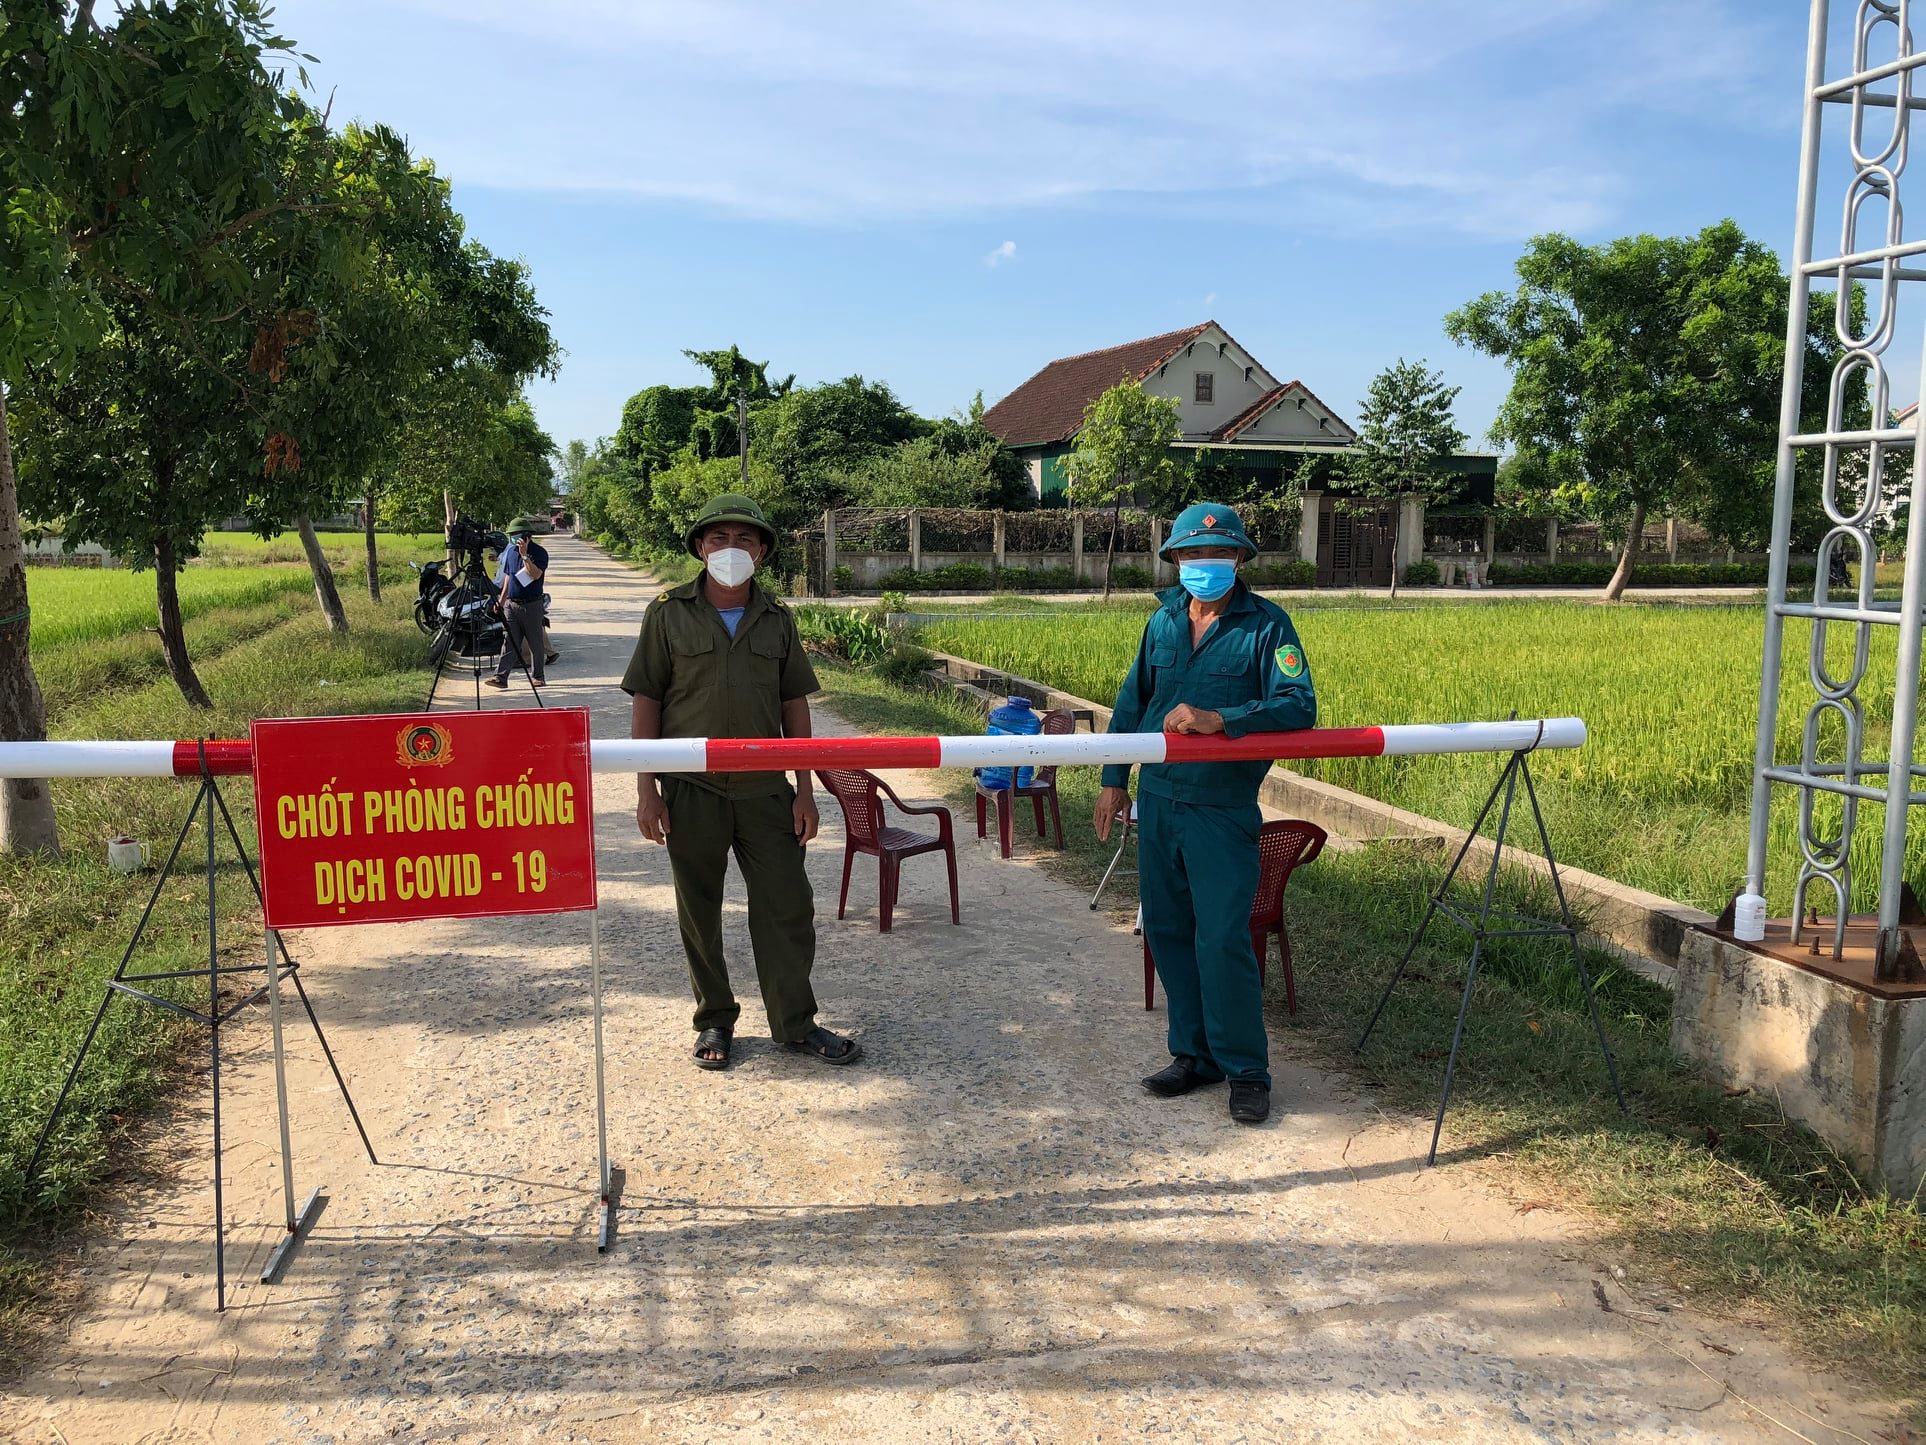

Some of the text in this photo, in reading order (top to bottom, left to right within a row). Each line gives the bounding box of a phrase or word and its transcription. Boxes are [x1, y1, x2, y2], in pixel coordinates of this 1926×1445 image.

[277, 768, 575, 839] CHỐT PHÒNG CHỐNG
[315, 850, 547, 914] DỊCH COVID - 19
